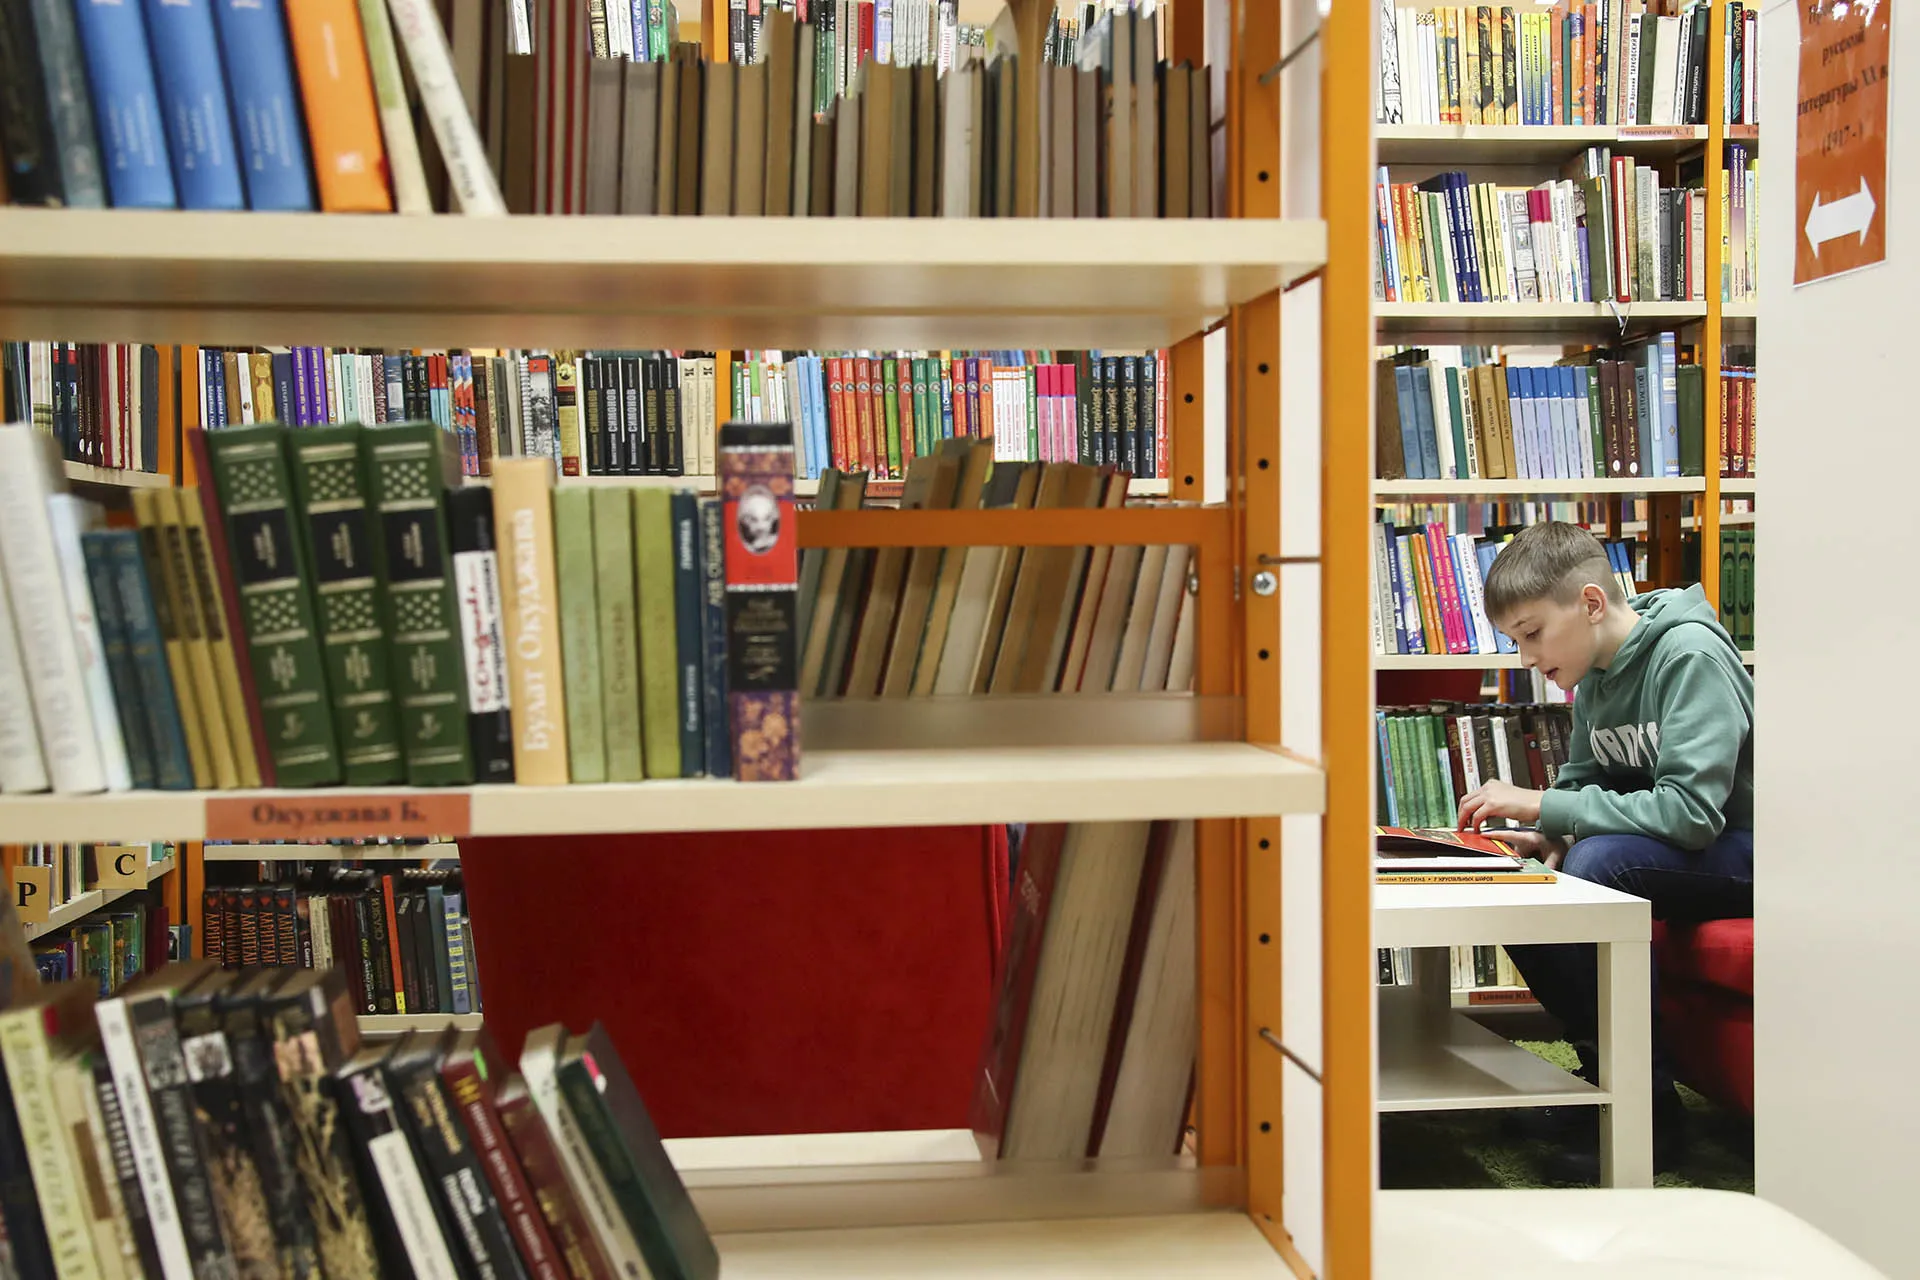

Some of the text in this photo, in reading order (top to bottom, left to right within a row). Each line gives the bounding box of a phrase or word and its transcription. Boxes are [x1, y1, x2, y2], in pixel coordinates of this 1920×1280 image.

[1630, 38, 1638, 75] ТАРКОВСКИЙ
[587, 390, 599, 433] СИМОНОВ
[607, 389, 618, 432] СИМОНОВ
[627, 389, 638, 432] СИМОНОВ
[647, 389, 658, 432] СИМОНОВ
[665, 389, 676, 433] СИМОНОВ
[509, 507, 555, 752] Булат Окуджава
[251, 799, 428, 830] Окуджава Б.
[114, 853, 137, 877] С
[15, 881, 38, 907] Р
[372, 898, 385, 941] СКАЗКИ
